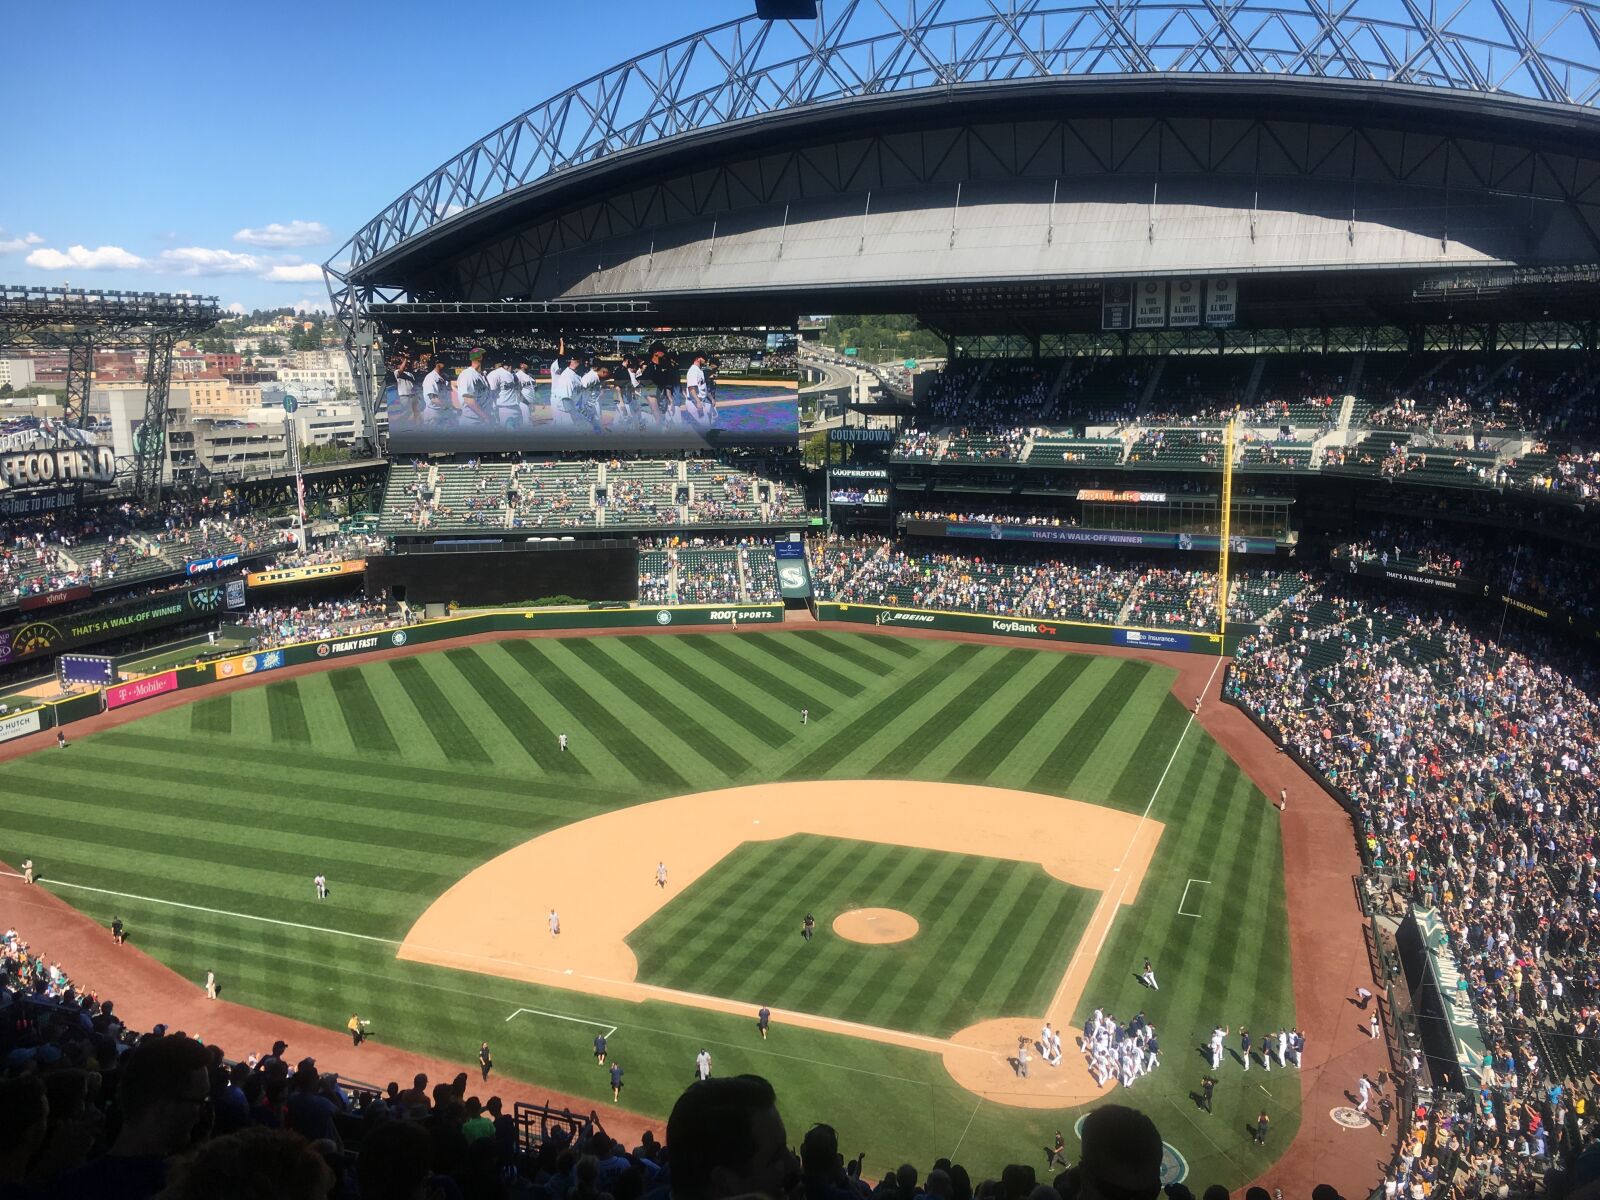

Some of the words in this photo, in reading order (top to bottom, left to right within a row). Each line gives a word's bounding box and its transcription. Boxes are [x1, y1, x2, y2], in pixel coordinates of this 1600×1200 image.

[831, 429, 890, 441] COUNTDOWN
[57, 446, 115, 482] FIELD
[832, 467, 887, 477] COOPERSTOWN
[864, 493, 870, 502] 4
[870, 494, 888, 502] DAYS
[1032, 531, 1058, 540] THAT'S
[1059, 532, 1066, 540] A
[1067, 533, 1108, 542] WALK-OFF
[1108, 534, 1143, 544] WINNER
[256, 571, 296, 583] THE
[1386, 571, 1403, 580] THAT'S
[1408, 575, 1434, 585] WALK-OFF
[1435, 580, 1457, 589] WINNER
[46, 592, 68, 603] xfinity
[72, 622, 101, 637] THAT'S
[102, 620, 109, 630] A
[110, 613, 150, 628] WALK-OFF
[151, 604, 182, 618] WINNER
[710, 610, 738, 620] ROOT
[738, 611, 774, 620] SPORTS
[894, 612, 935, 622] BOEING
[992, 620, 1038, 634] KeyBank
[332, 640, 358, 653] FREAKY
[358, 637, 378, 648] FAST!
[6, 718, 30, 729] HUTCH
